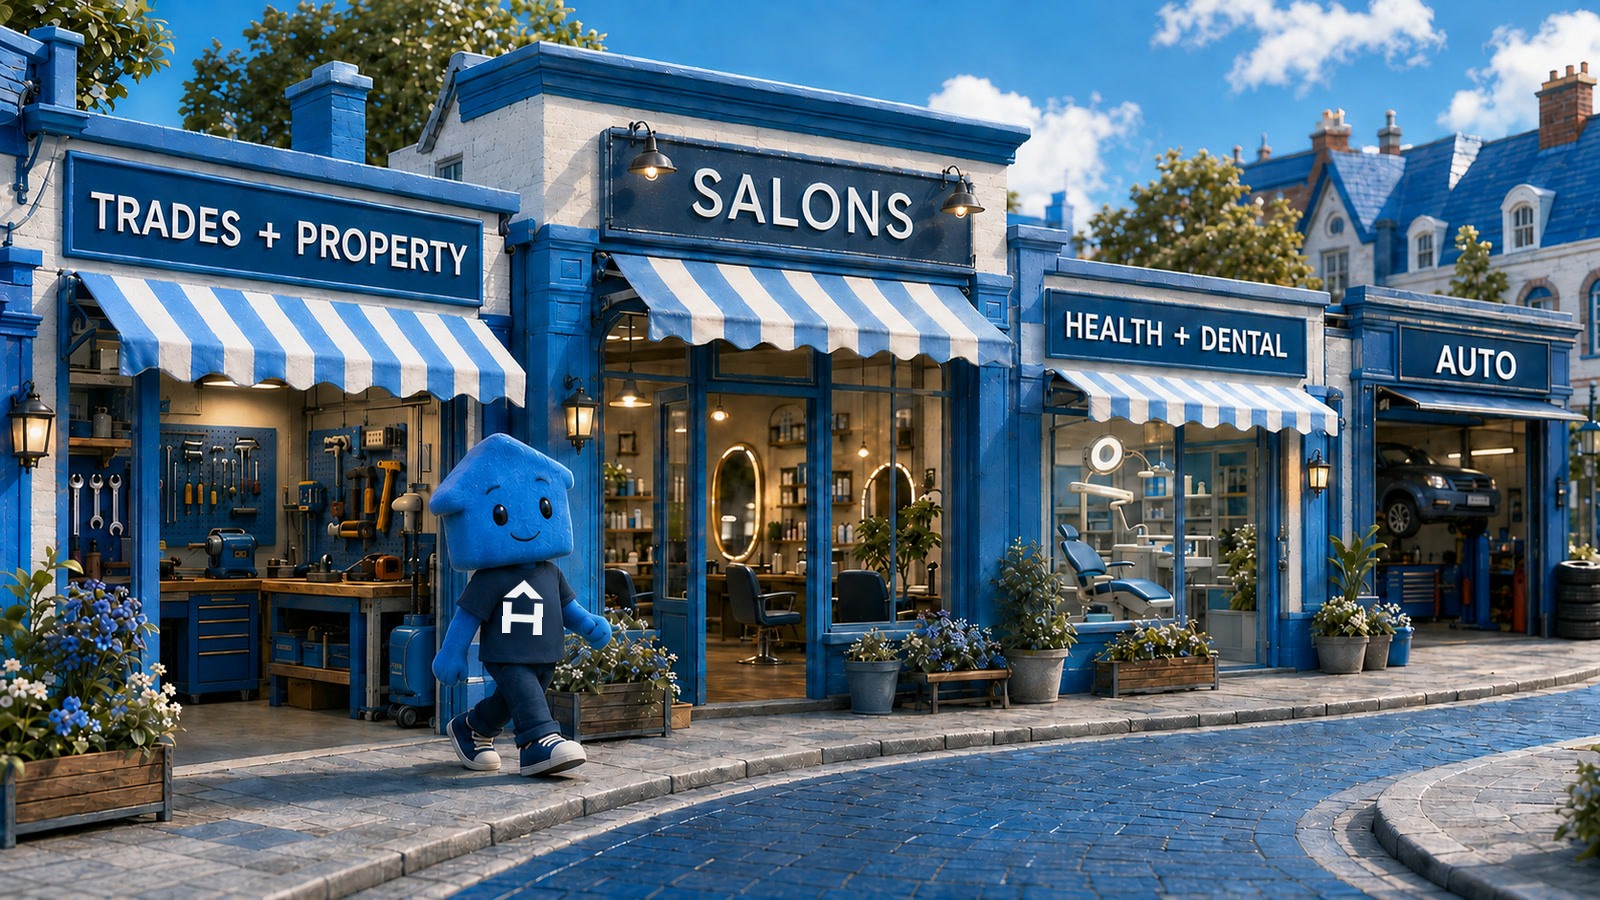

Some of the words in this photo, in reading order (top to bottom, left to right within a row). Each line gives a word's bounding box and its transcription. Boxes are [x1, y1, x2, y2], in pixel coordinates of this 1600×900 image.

[90, 191, 241, 247] TRADES
[258, 222, 281, 248] +
[297, 220, 468, 276] PROPERTY
[692, 167, 915, 240] SALONS
[1065, 310, 1163, 346] HEALTH
[1174, 326, 1190, 346] +
[1201, 325, 1288, 358] DENTAL
[1435, 344, 1517, 380] AUTO
